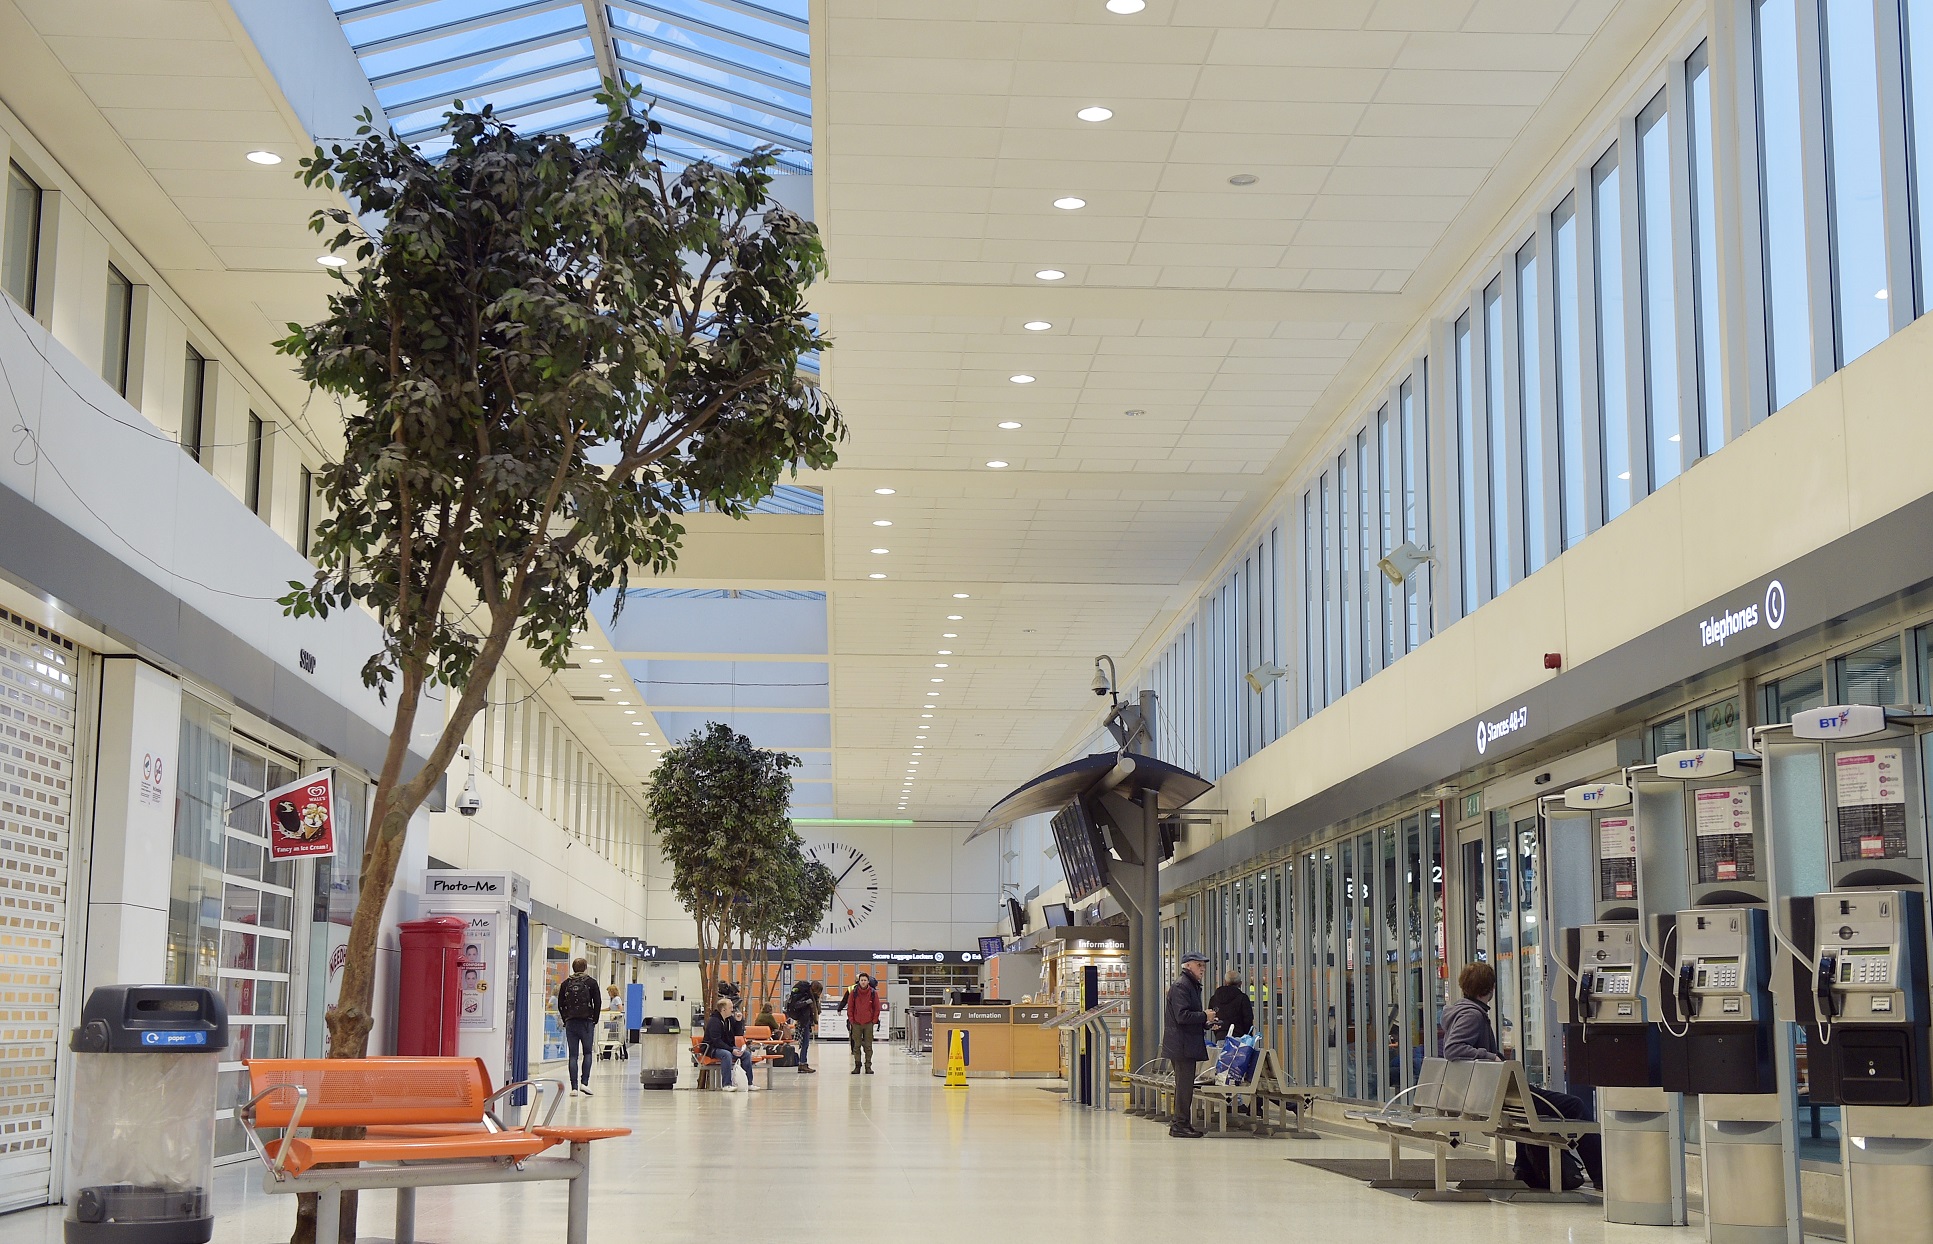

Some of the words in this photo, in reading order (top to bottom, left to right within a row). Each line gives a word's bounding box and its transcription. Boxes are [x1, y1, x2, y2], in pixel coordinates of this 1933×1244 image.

[1699, 603, 1758, 647] Telephones
[299, 648, 317, 675] SHOP
[1487, 718, 1510, 742] Stances
[1509, 706, 1528, 731] 48-57
[1819, 717, 1839, 729] BT
[1679, 759, 1696, 769] BT
[1583, 792, 1597, 801] BT
[433, 880, 498, 892] Photo-Me
[1078, 940, 1125, 949] Information
[891, 953, 913, 961] Luggage
[476, 983, 487, 991] £5
